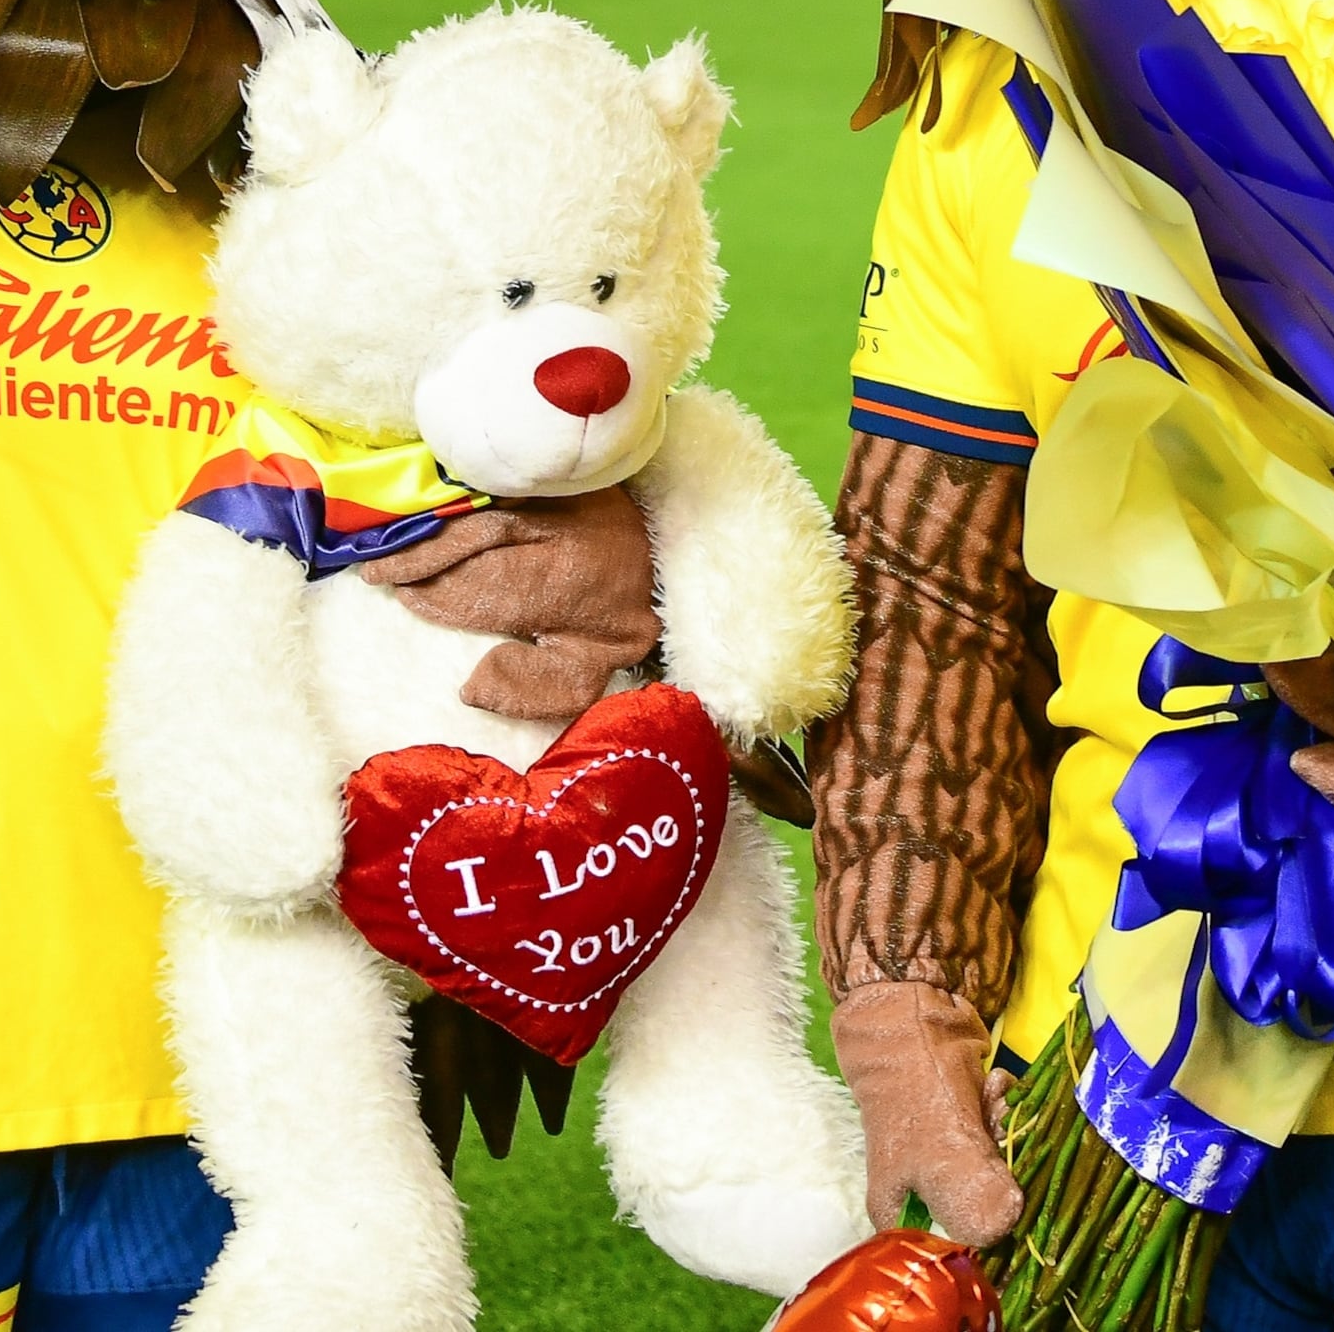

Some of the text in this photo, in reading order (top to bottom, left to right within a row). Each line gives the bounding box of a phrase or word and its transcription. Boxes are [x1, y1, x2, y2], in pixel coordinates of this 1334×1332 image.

[445, 815, 679, 916] I Love
[514, 918, 641, 973] You
